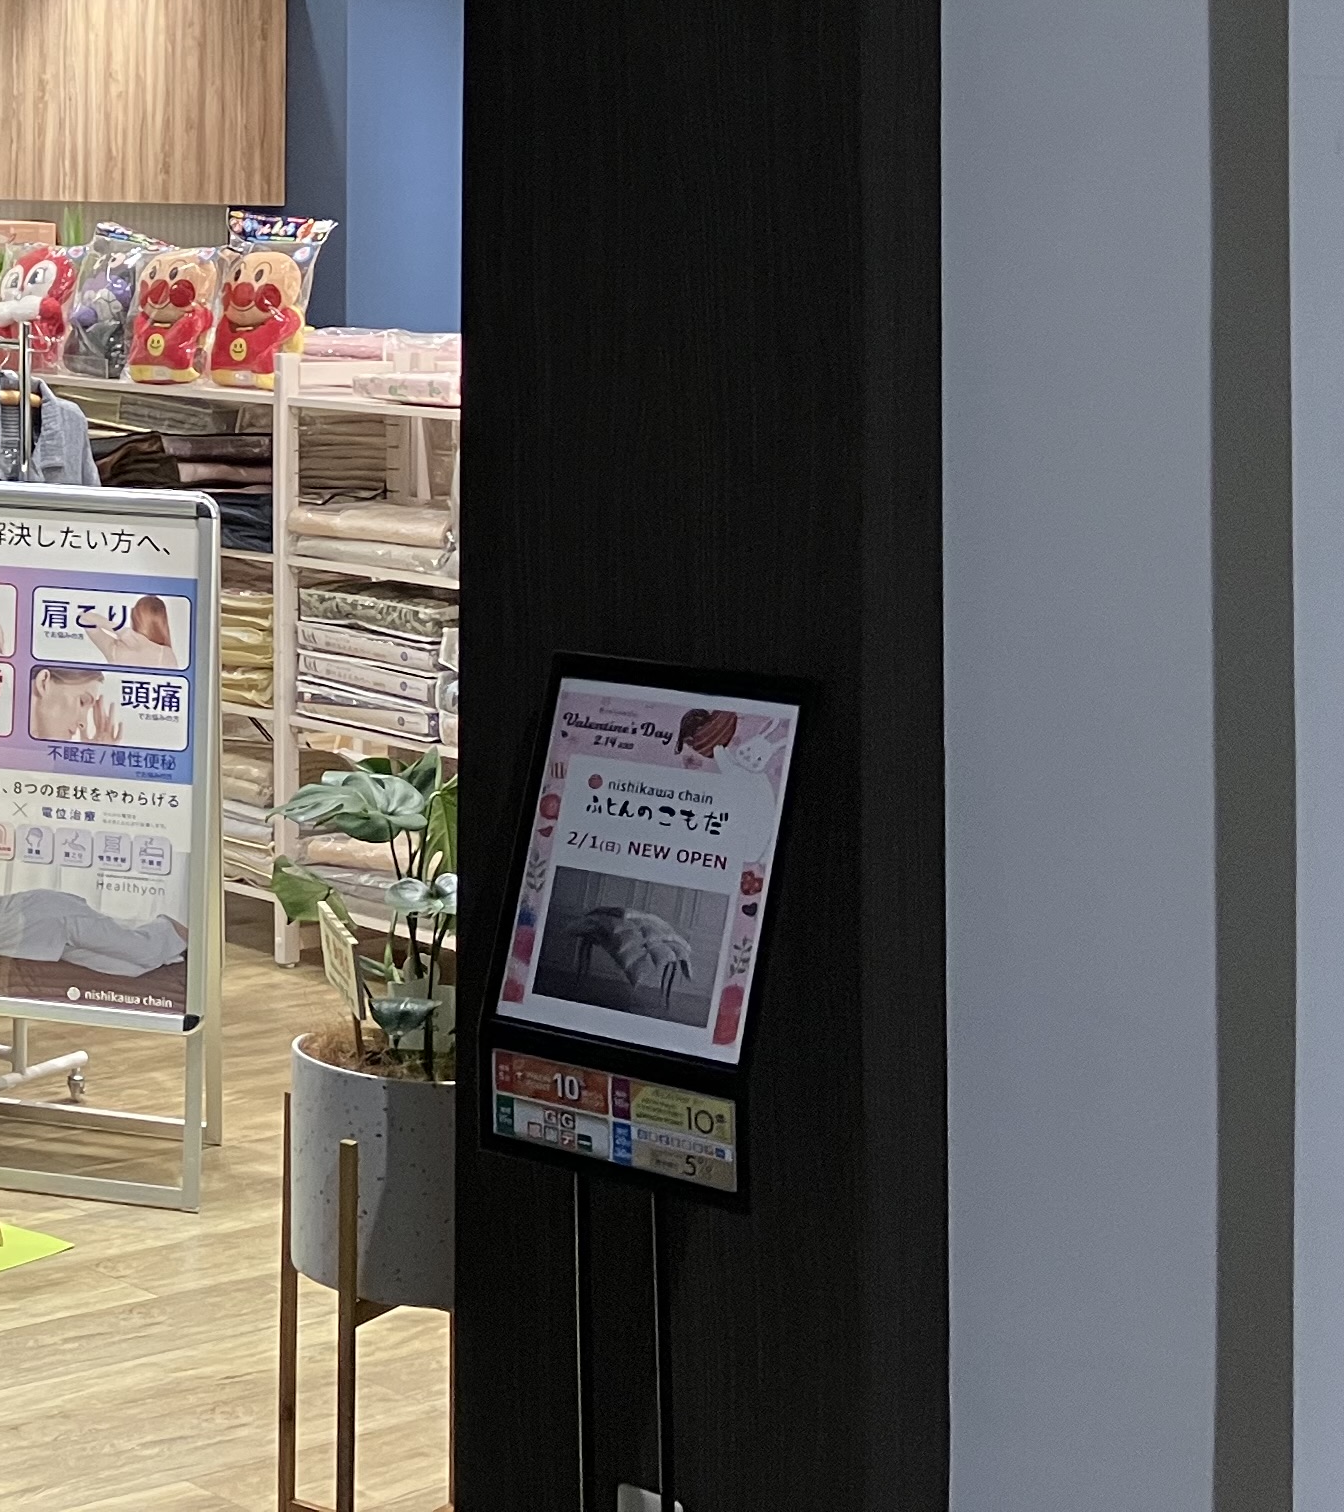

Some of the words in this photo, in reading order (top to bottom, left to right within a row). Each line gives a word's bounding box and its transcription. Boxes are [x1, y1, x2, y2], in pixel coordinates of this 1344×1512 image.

[40, 599, 127, 632] 肩こり
[120, 679, 183, 713] 頭痛
[563, 711, 638, 735] Valentine's
[640, 722, 673, 745] Day
[608, 779, 675, 799] nishikawa
[678, 790, 714, 805] chain
[41, 806, 96, 822] 電位治療
[567, 831, 622, 855] 2/1(日)
[627, 841, 671, 860] NEW
[676, 849, 728, 870] OPEN
[96, 880, 166, 896] Healthyon
[84, 989, 141, 1005] nishikawa
[142, 995, 173, 1008] chain
